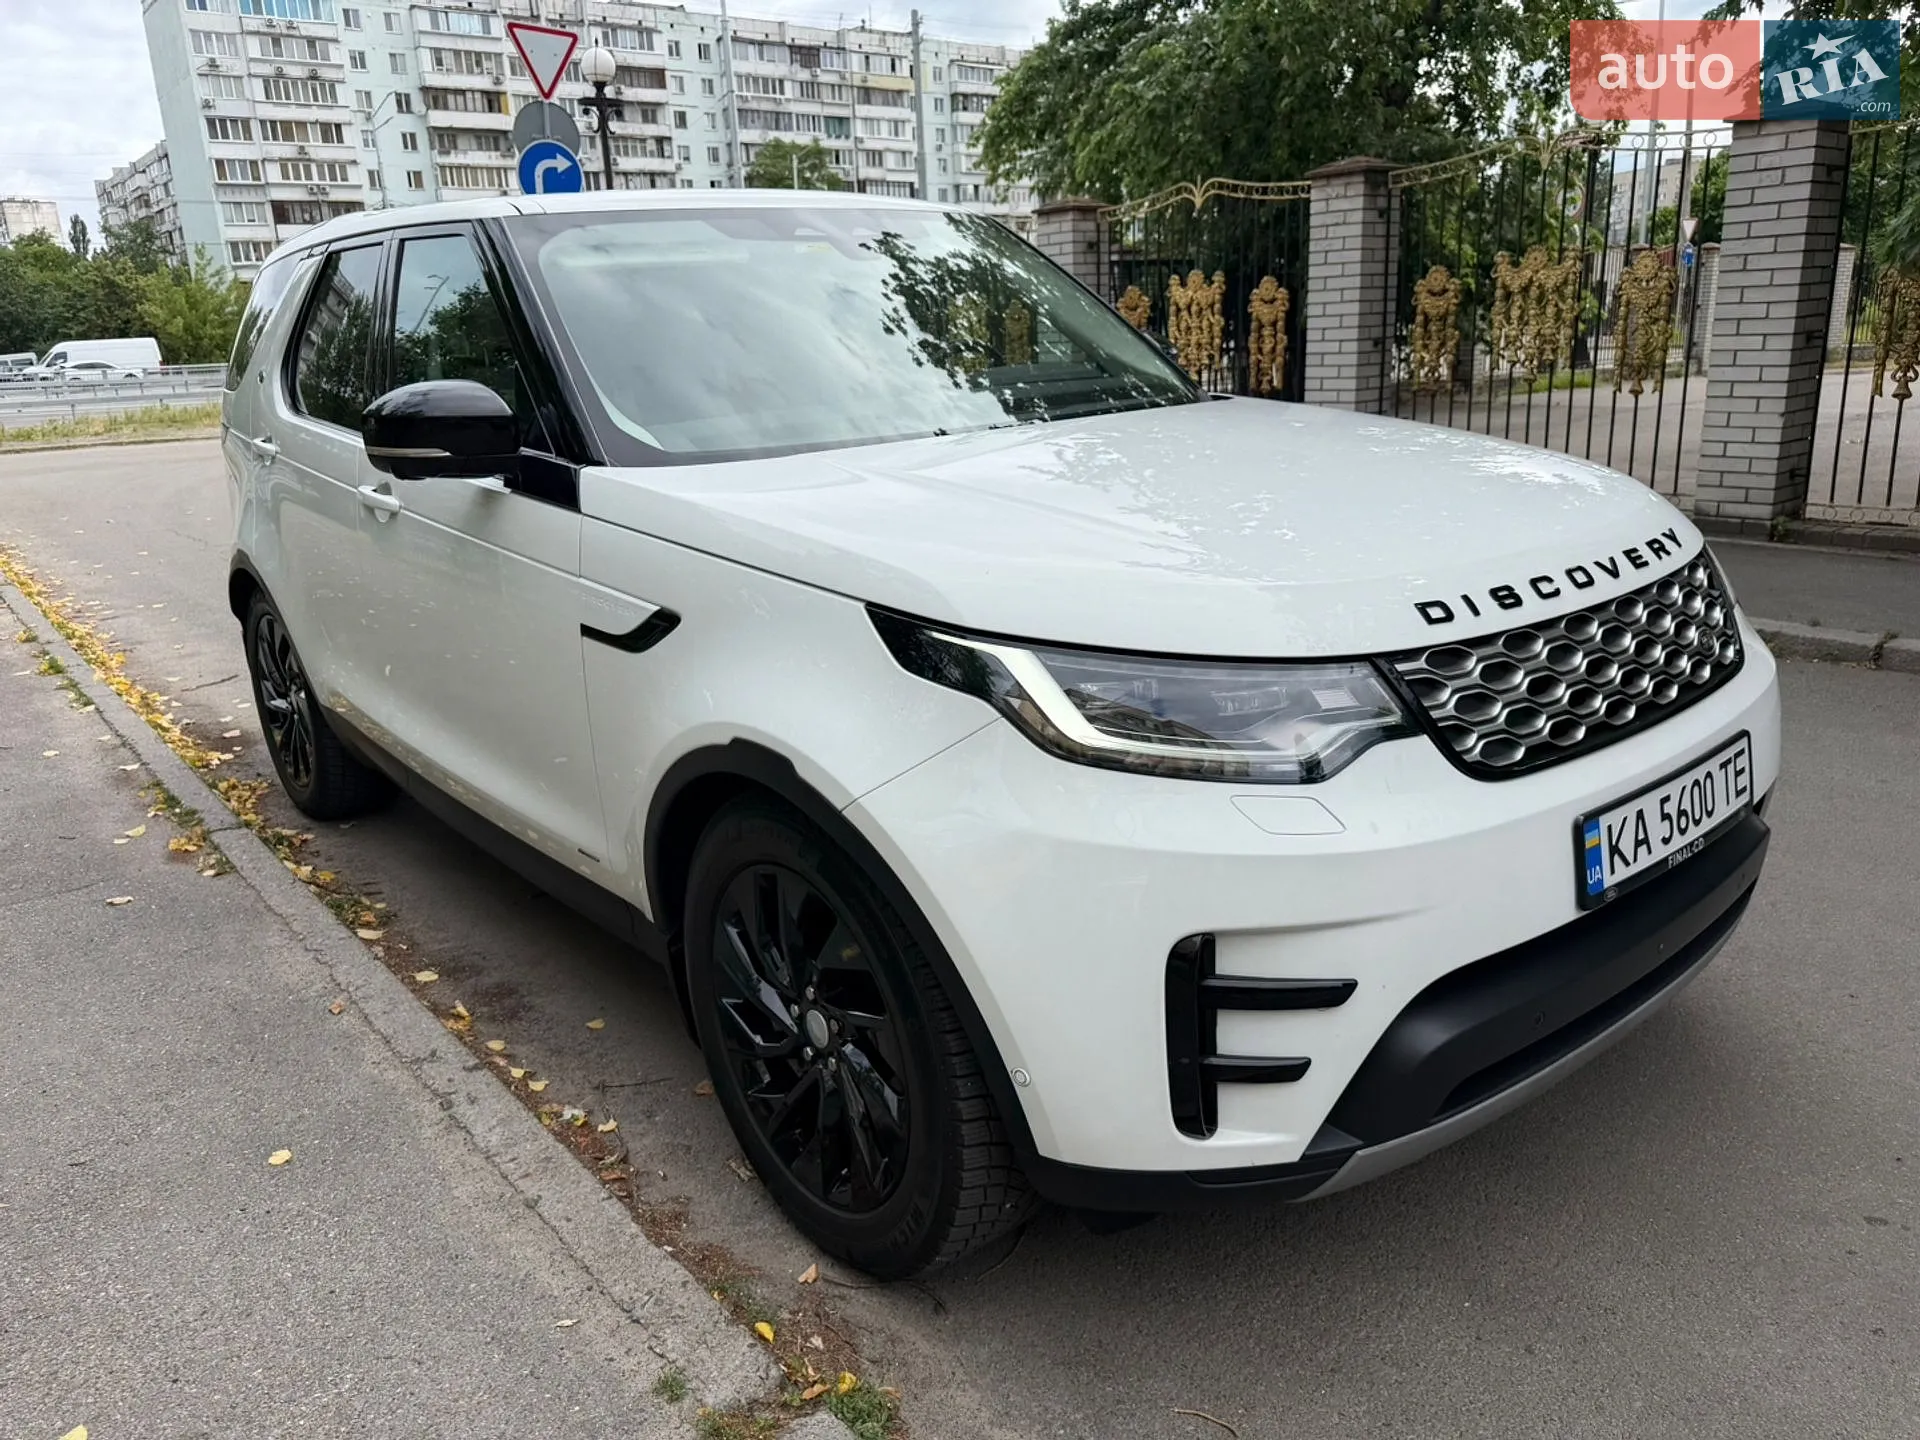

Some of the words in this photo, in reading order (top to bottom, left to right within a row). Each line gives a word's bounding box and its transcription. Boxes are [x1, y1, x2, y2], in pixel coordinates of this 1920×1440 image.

[1414, 528, 1683, 625] DISCOVERY
[1607, 808, 1652, 876] KA
[1659, 770, 1716, 846] 5600
[1719, 747, 1748, 806] TE
[1587, 865, 1602, 884] UA
